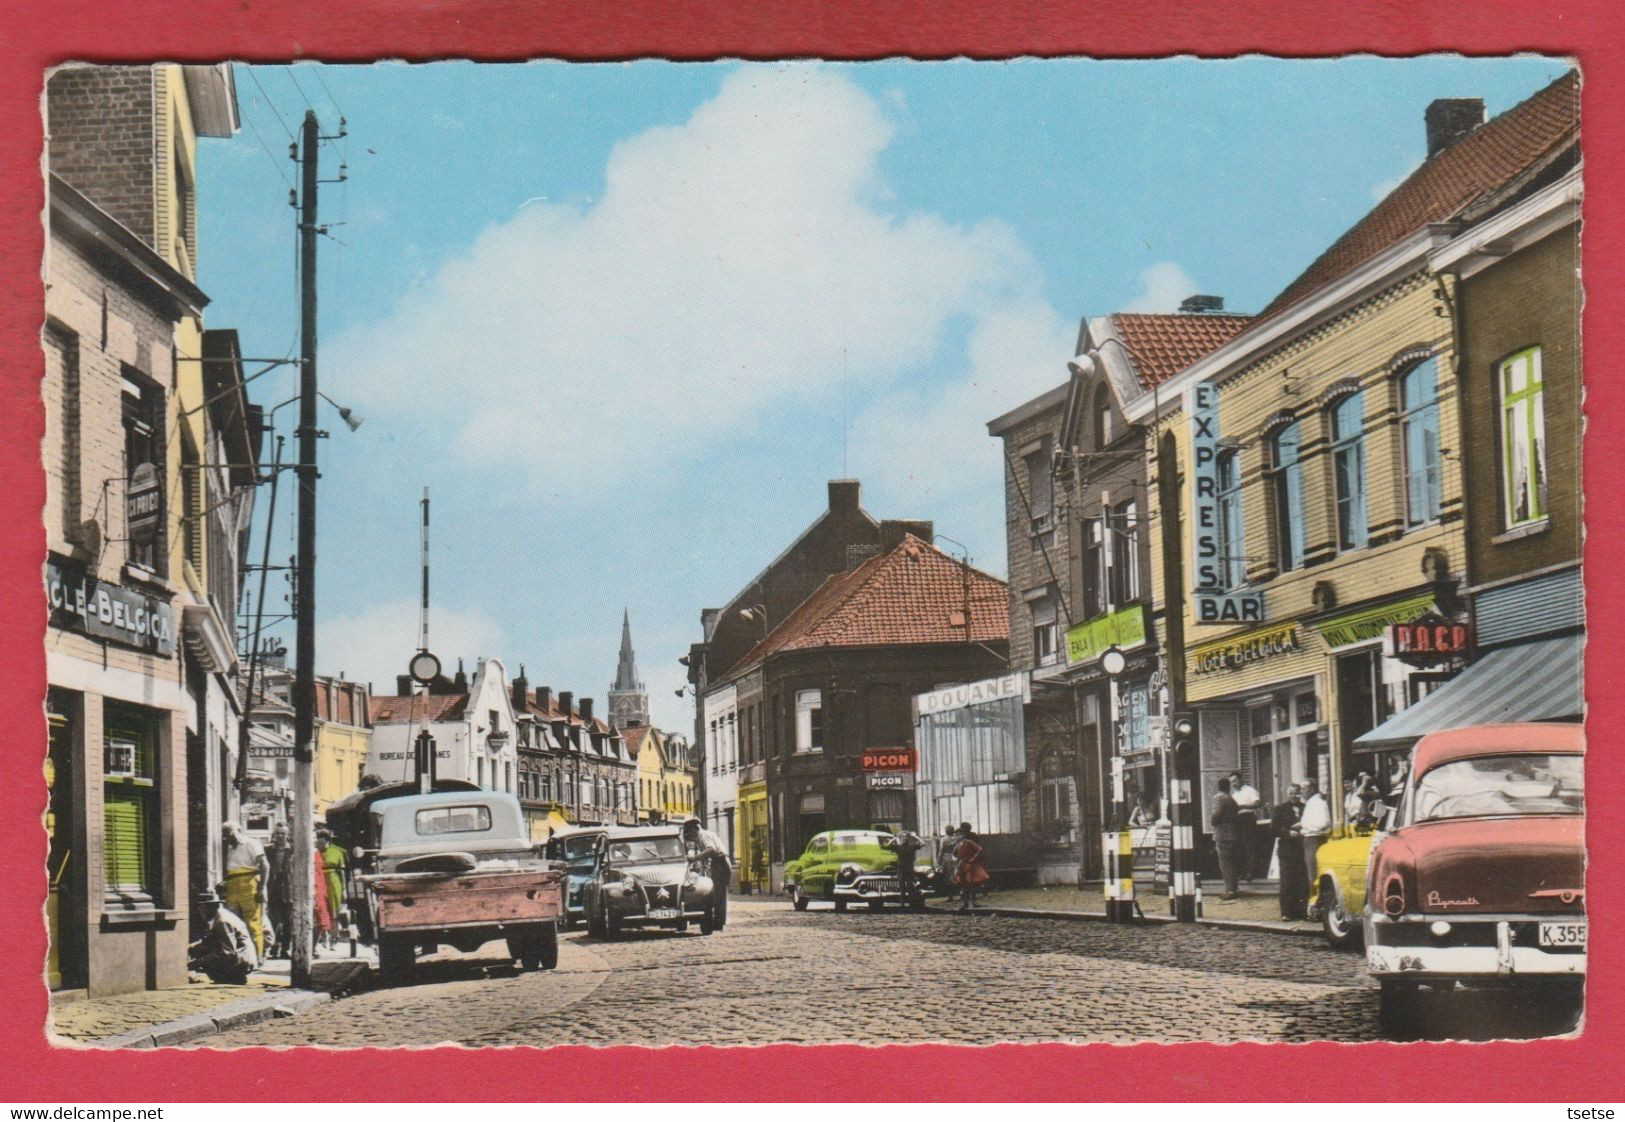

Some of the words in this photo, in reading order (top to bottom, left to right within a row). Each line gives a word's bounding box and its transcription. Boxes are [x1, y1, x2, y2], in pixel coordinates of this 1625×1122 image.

[1193, 386, 1217, 588] EXPRESS
[1200, 597, 1261, 621] BAR
[927, 678, 1015, 710] DOUANE
[379, 752, 404, 760] BUREAU
[863, 754, 909, 767] PICON
[871, 777, 902, 786] PICON
[1427, 890, 1480, 908] Plymouth
